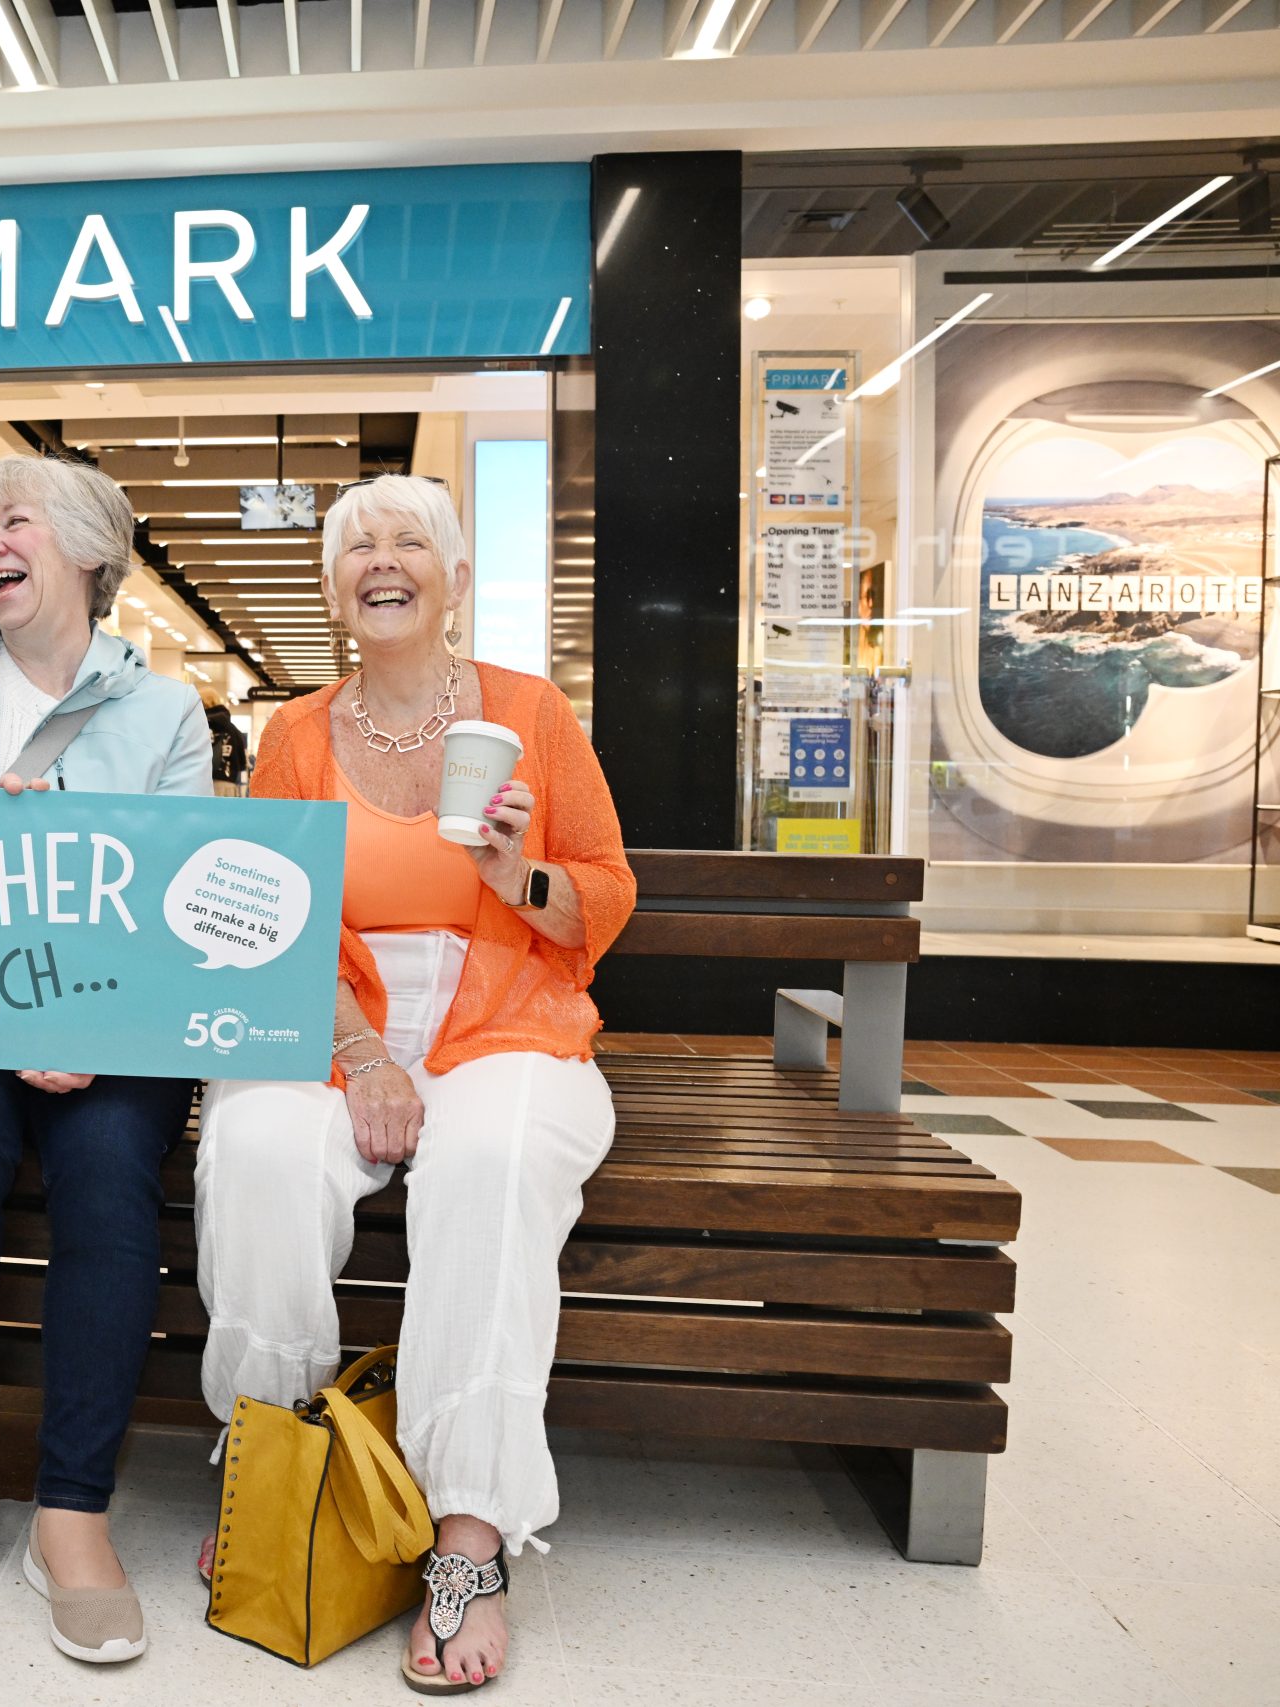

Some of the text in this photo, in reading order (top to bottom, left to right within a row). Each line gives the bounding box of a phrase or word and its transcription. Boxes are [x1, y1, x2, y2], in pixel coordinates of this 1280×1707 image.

[768, 527, 839, 536] Opening Times
[996, 580, 1258, 604] LANZAROTE
[447, 762, 488, 780] Dnisi
[215, 857, 281, 887] Sometimes
[206, 872, 280, 904] the smallest
[195, 888, 280, 922] conversations
[185, 902, 279, 943] can make a big
[193, 920, 258, 950] difference.
[214, 1007, 249, 1024] CELEBRATING
[183, 1012, 245, 1048] 50
[249, 1026, 300, 1038] the centre
[213, 1046, 230, 1055] YEARS
